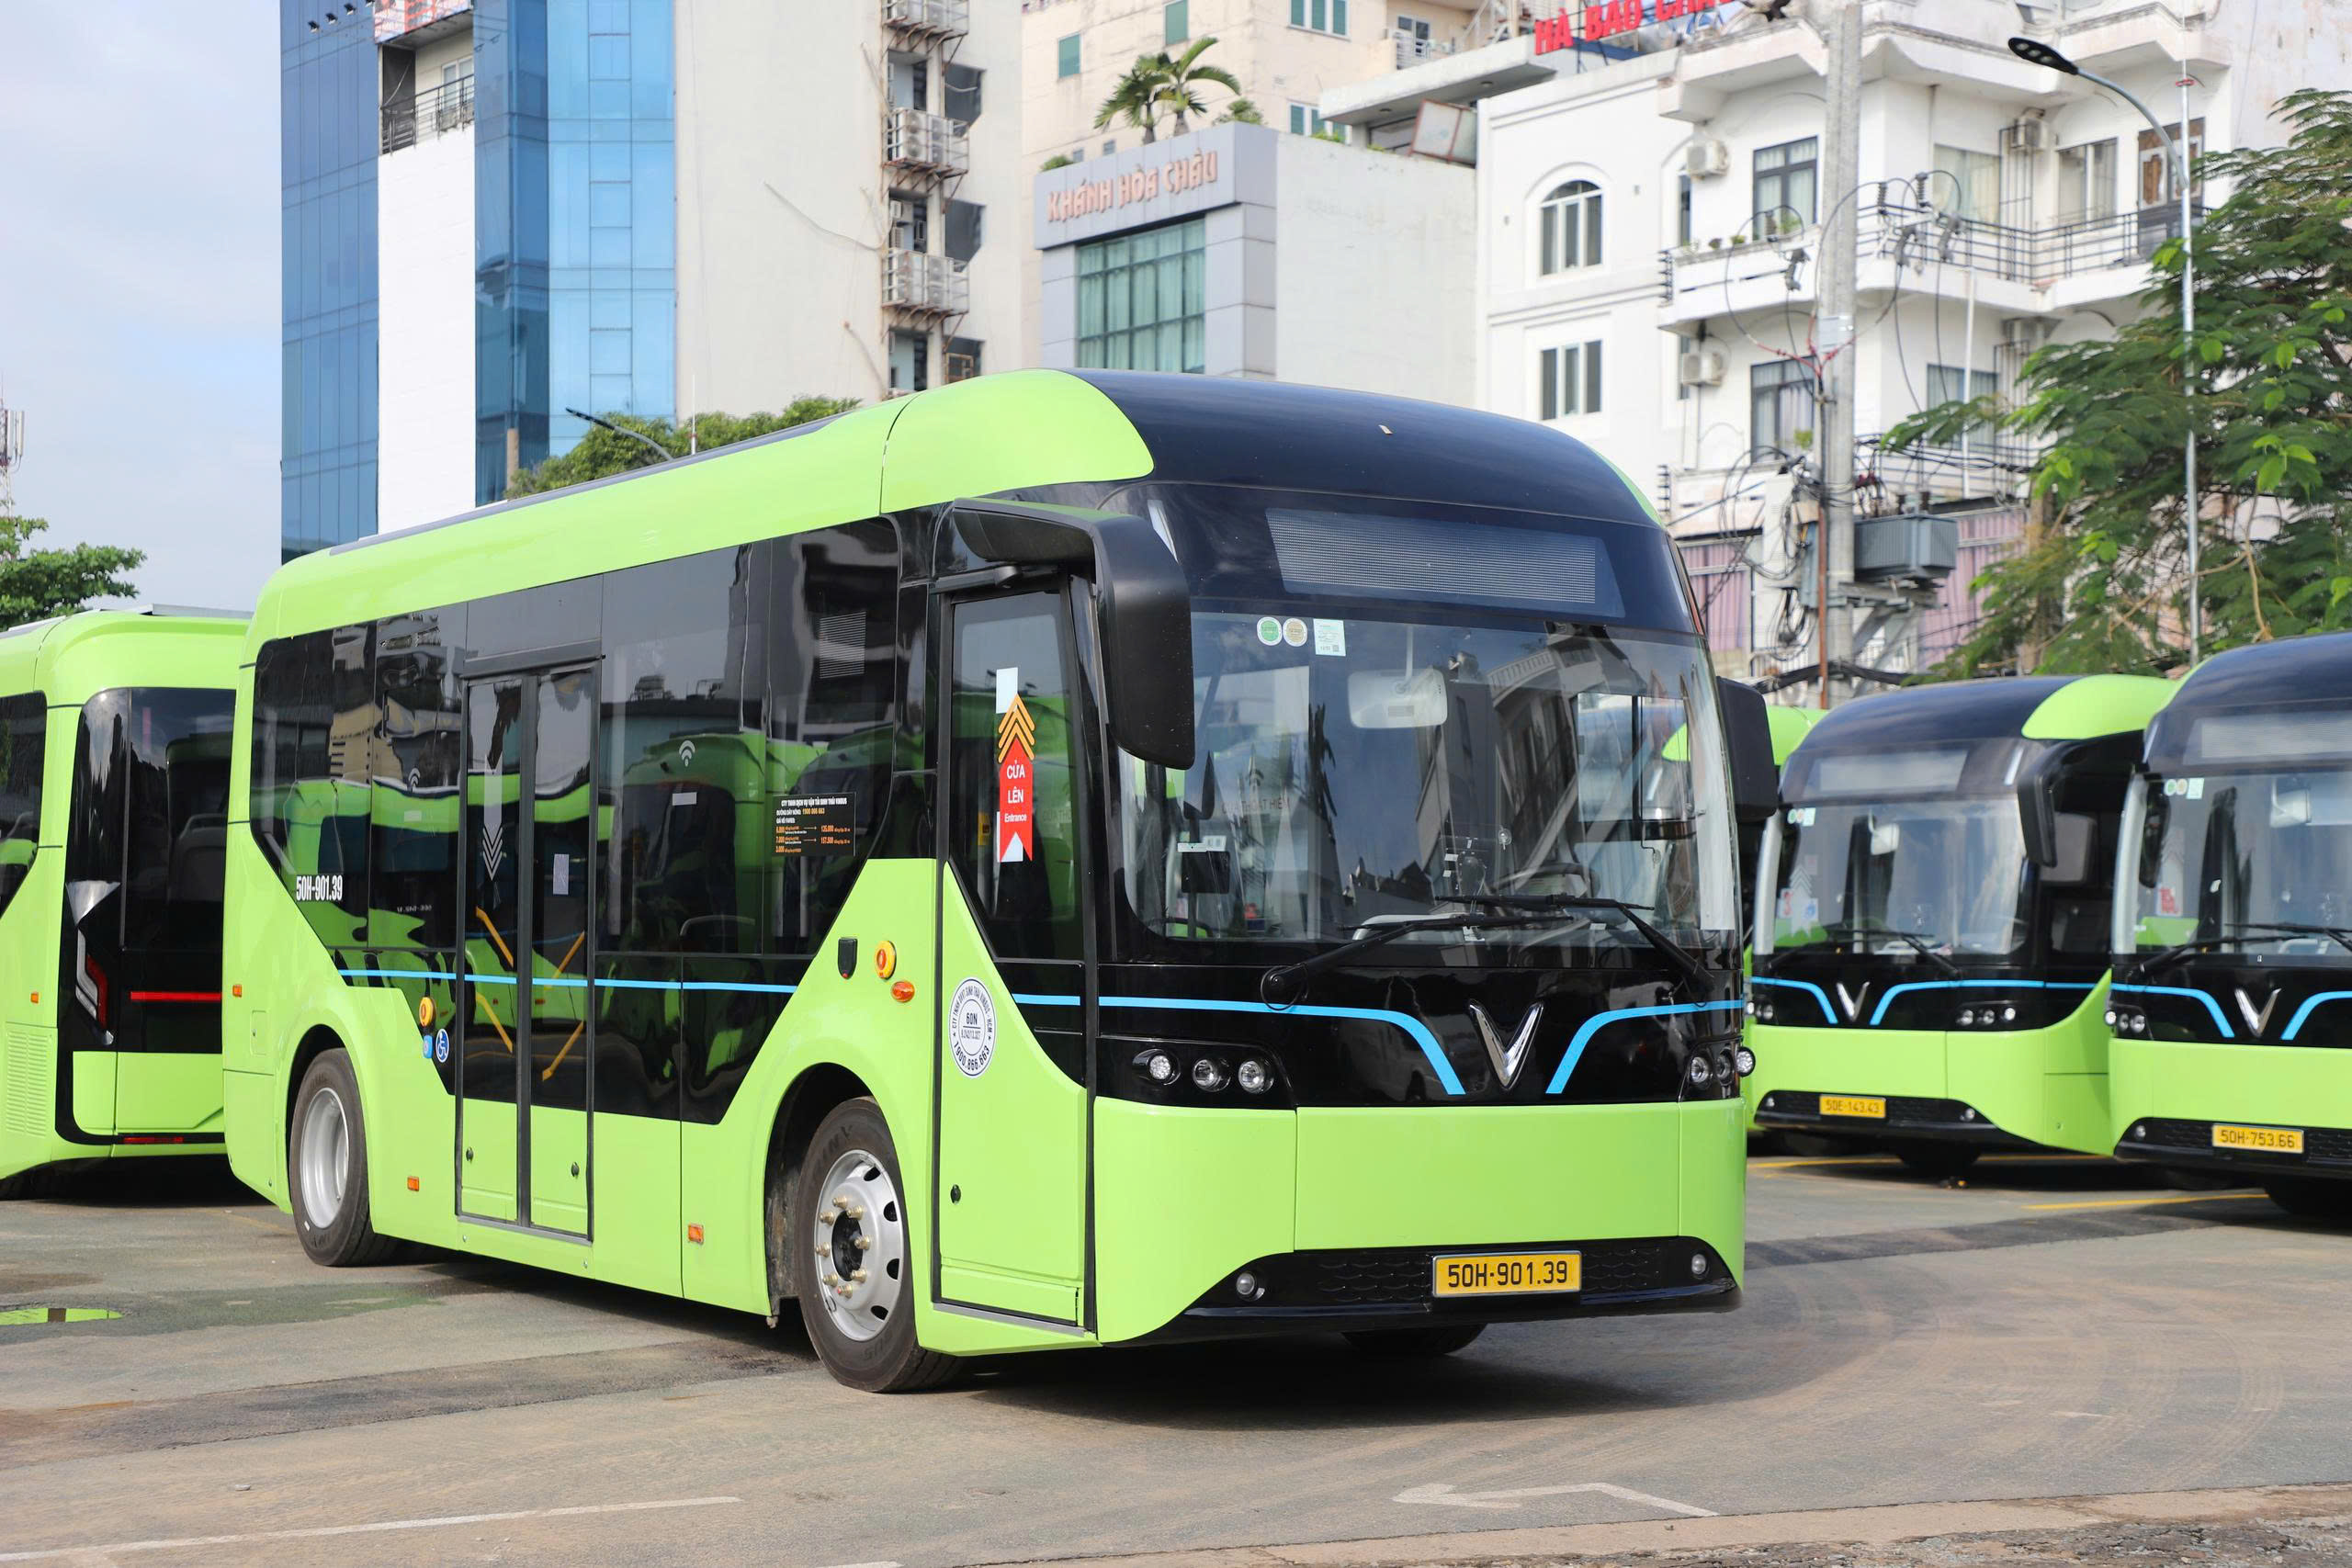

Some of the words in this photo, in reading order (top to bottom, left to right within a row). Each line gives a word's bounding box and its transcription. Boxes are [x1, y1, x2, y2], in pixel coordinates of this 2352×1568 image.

[1534, 7, 1574, 55] HÀ
[1047, 178, 1114, 222] KHÁNH
[1119, 164, 1159, 209] HÒA
[1163, 147, 1218, 195] CHÂU
[1007, 759, 1025, 779] CỬA
[1008, 786, 1023, 804] LÊN
[1004, 813, 1027, 823] Entrance
[296, 874, 343, 901] 50H-901.39
[966, 1012, 978, 1025] 60N
[2220, 1129, 2295, 1148] 50H-753.66
[1448, 1260, 1567, 1288] 50H-901.39
